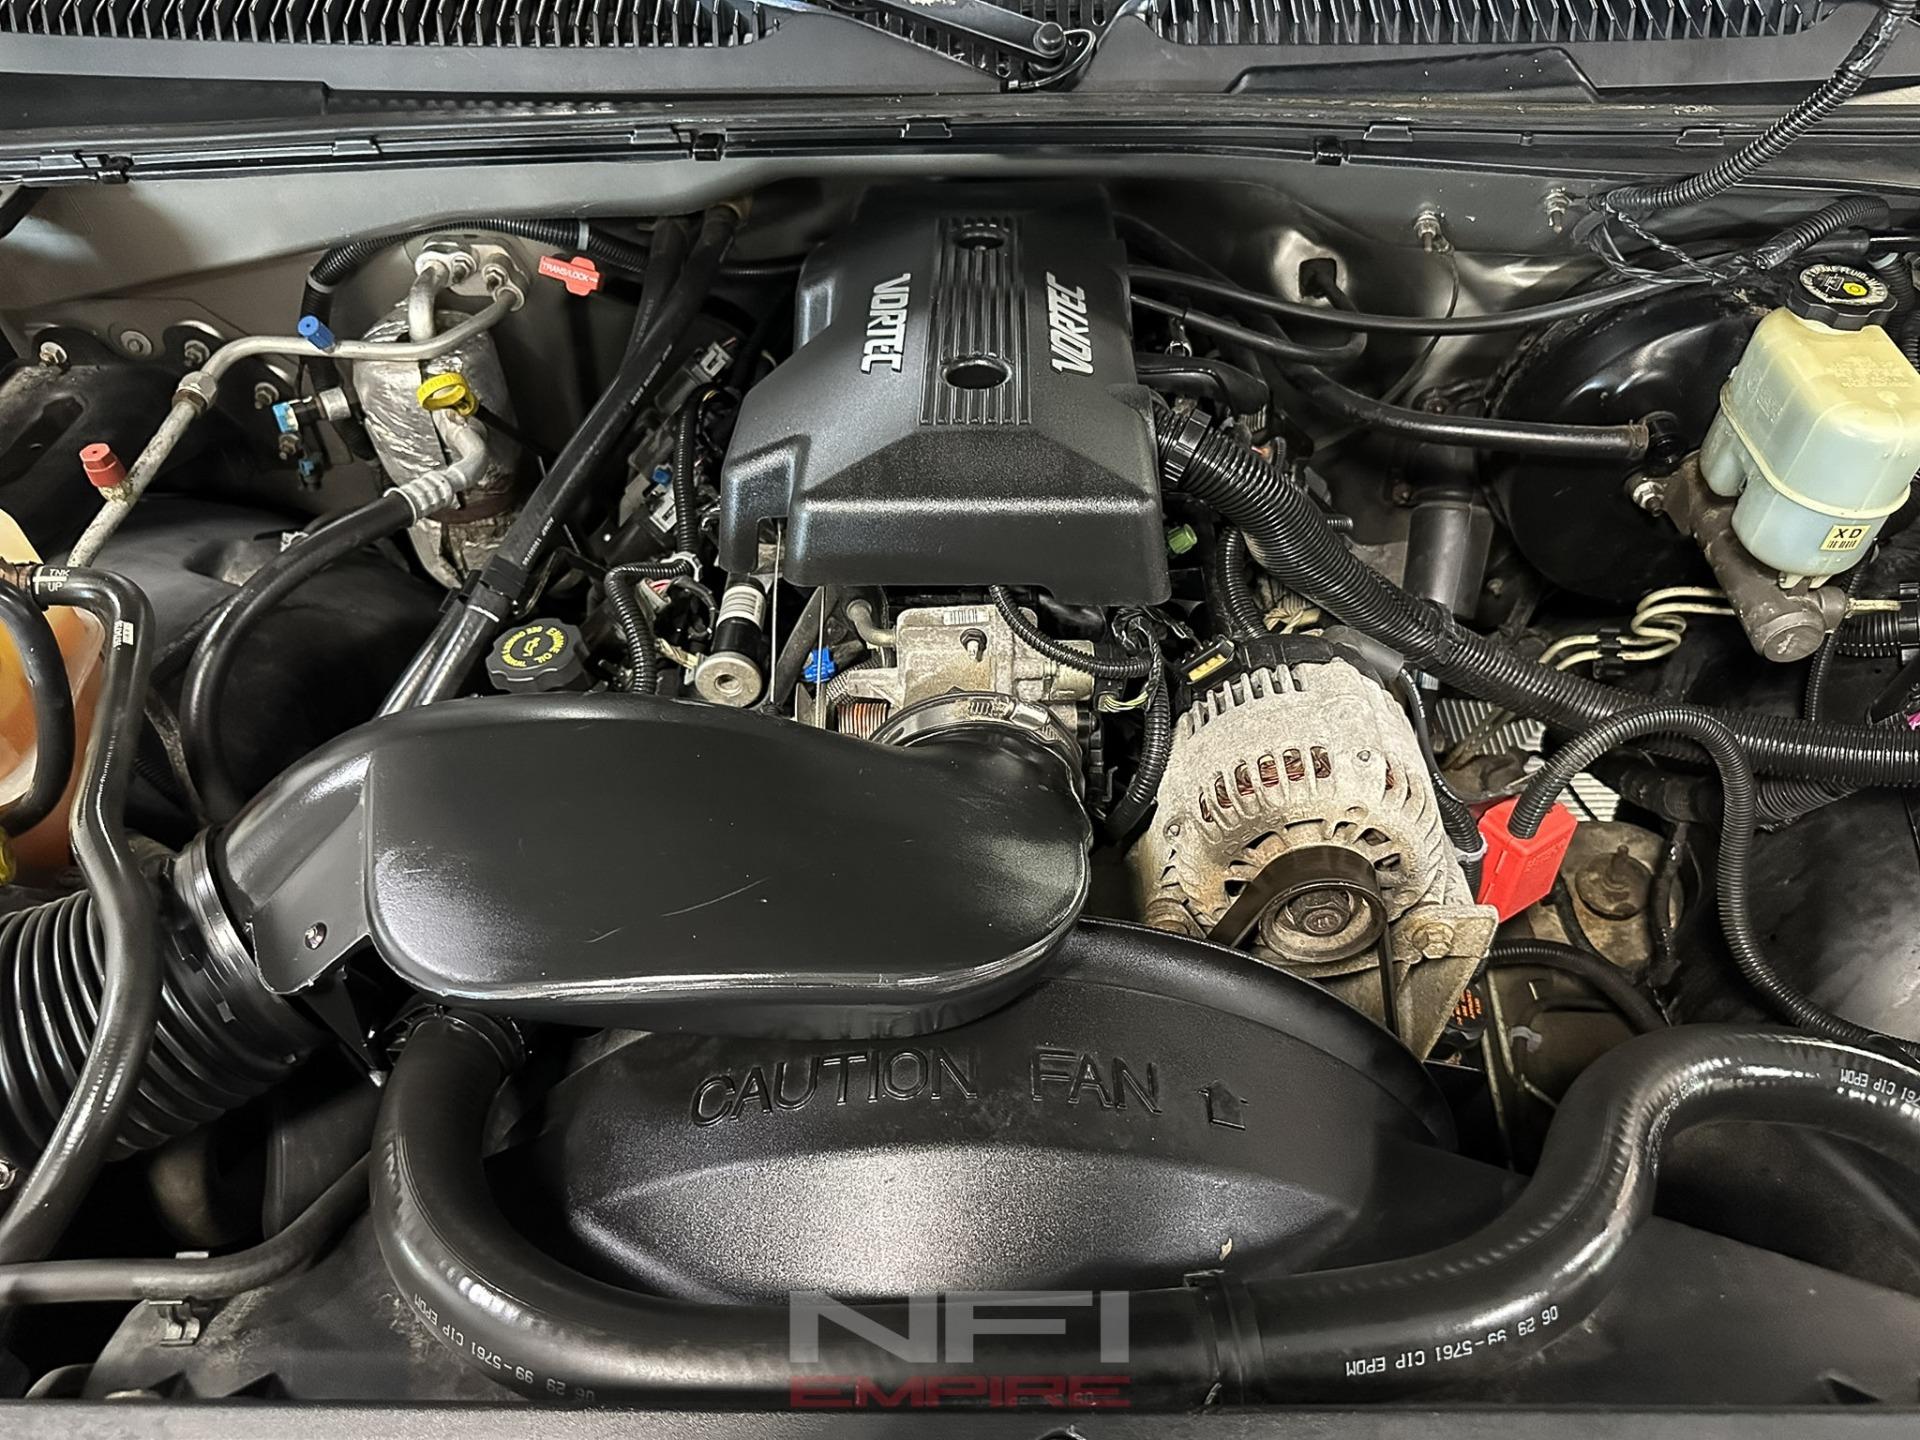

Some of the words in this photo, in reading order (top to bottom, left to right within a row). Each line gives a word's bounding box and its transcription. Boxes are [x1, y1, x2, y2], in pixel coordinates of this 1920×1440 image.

[861, 273, 911, 374] VORTEC
[1046, 271, 1094, 374] VORTEC
[48, 581, 63, 591] UP
[533, 652, 553, 664] OIL
[691, 1046, 980, 1127] CAUTION
[1030, 1045, 1162, 1117] FAN
[1840, 1068, 1869, 1087] EPDM
[1873, 1078, 1896, 1095] CIP
[1541, 1305, 1558, 1325] 06
[442, 1324, 464, 1346] CIP
[1518, 1316, 1536, 1336] 29
[471, 1342, 534, 1384] 99-5761
[1346, 1356, 1386, 1377] EPDM
[1395, 1350, 1425, 1369] CIP
[546, 1378, 566, 1396] 29
